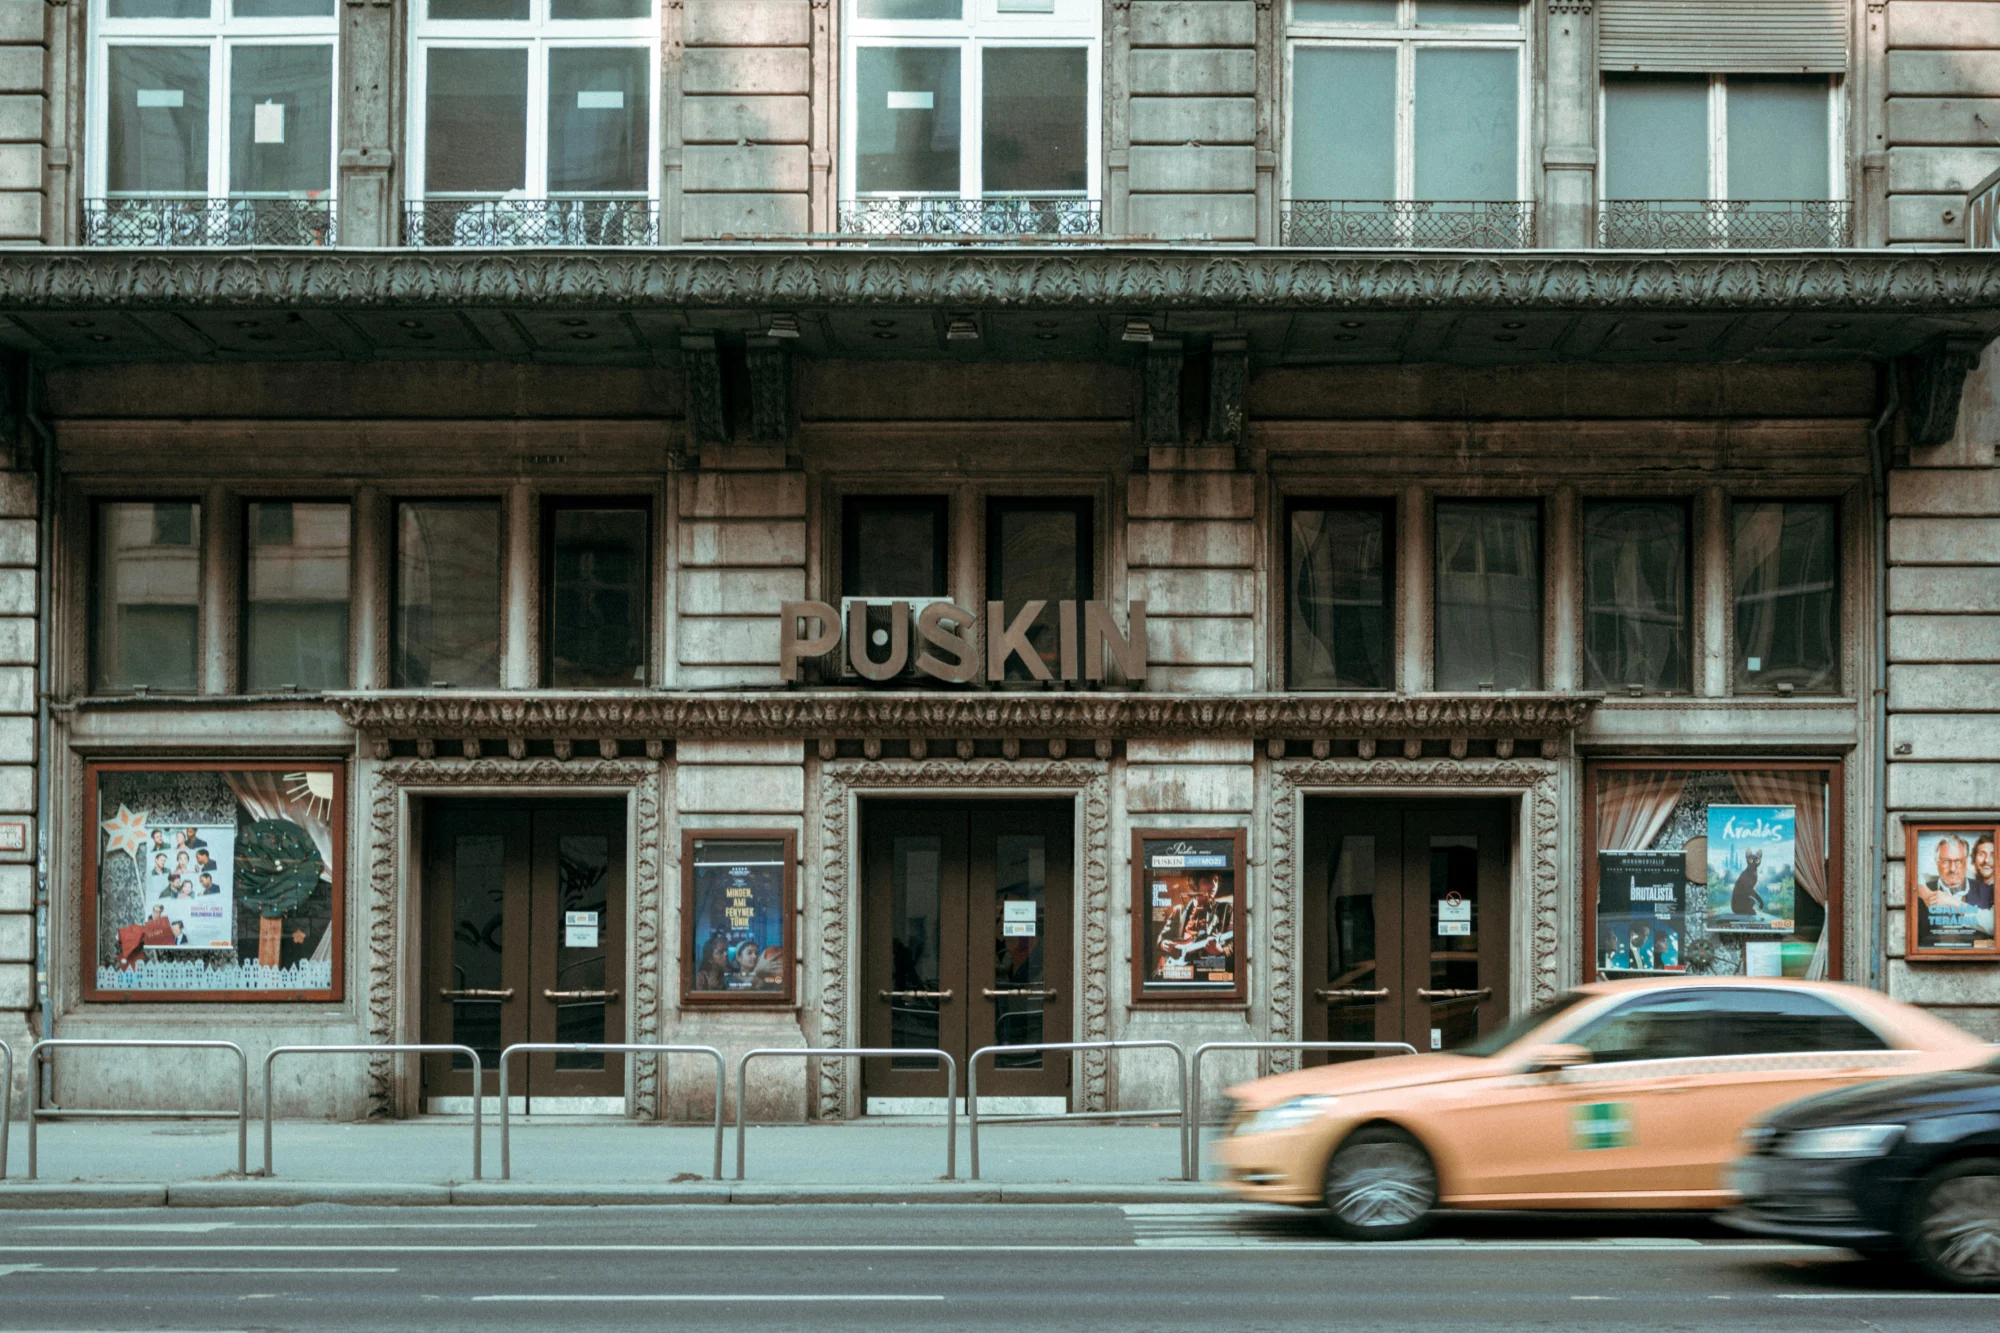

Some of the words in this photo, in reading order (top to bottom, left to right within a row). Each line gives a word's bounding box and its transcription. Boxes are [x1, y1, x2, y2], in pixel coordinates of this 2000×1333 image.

[780, 600, 1147, 684] PUSKIN
[1722, 815, 1783, 841] Áradás
[1165, 841, 1197, 856] Puskin
[1630, 887, 1674, 901] BRUTALISTA
[733, 898, 746, 907] AMI
